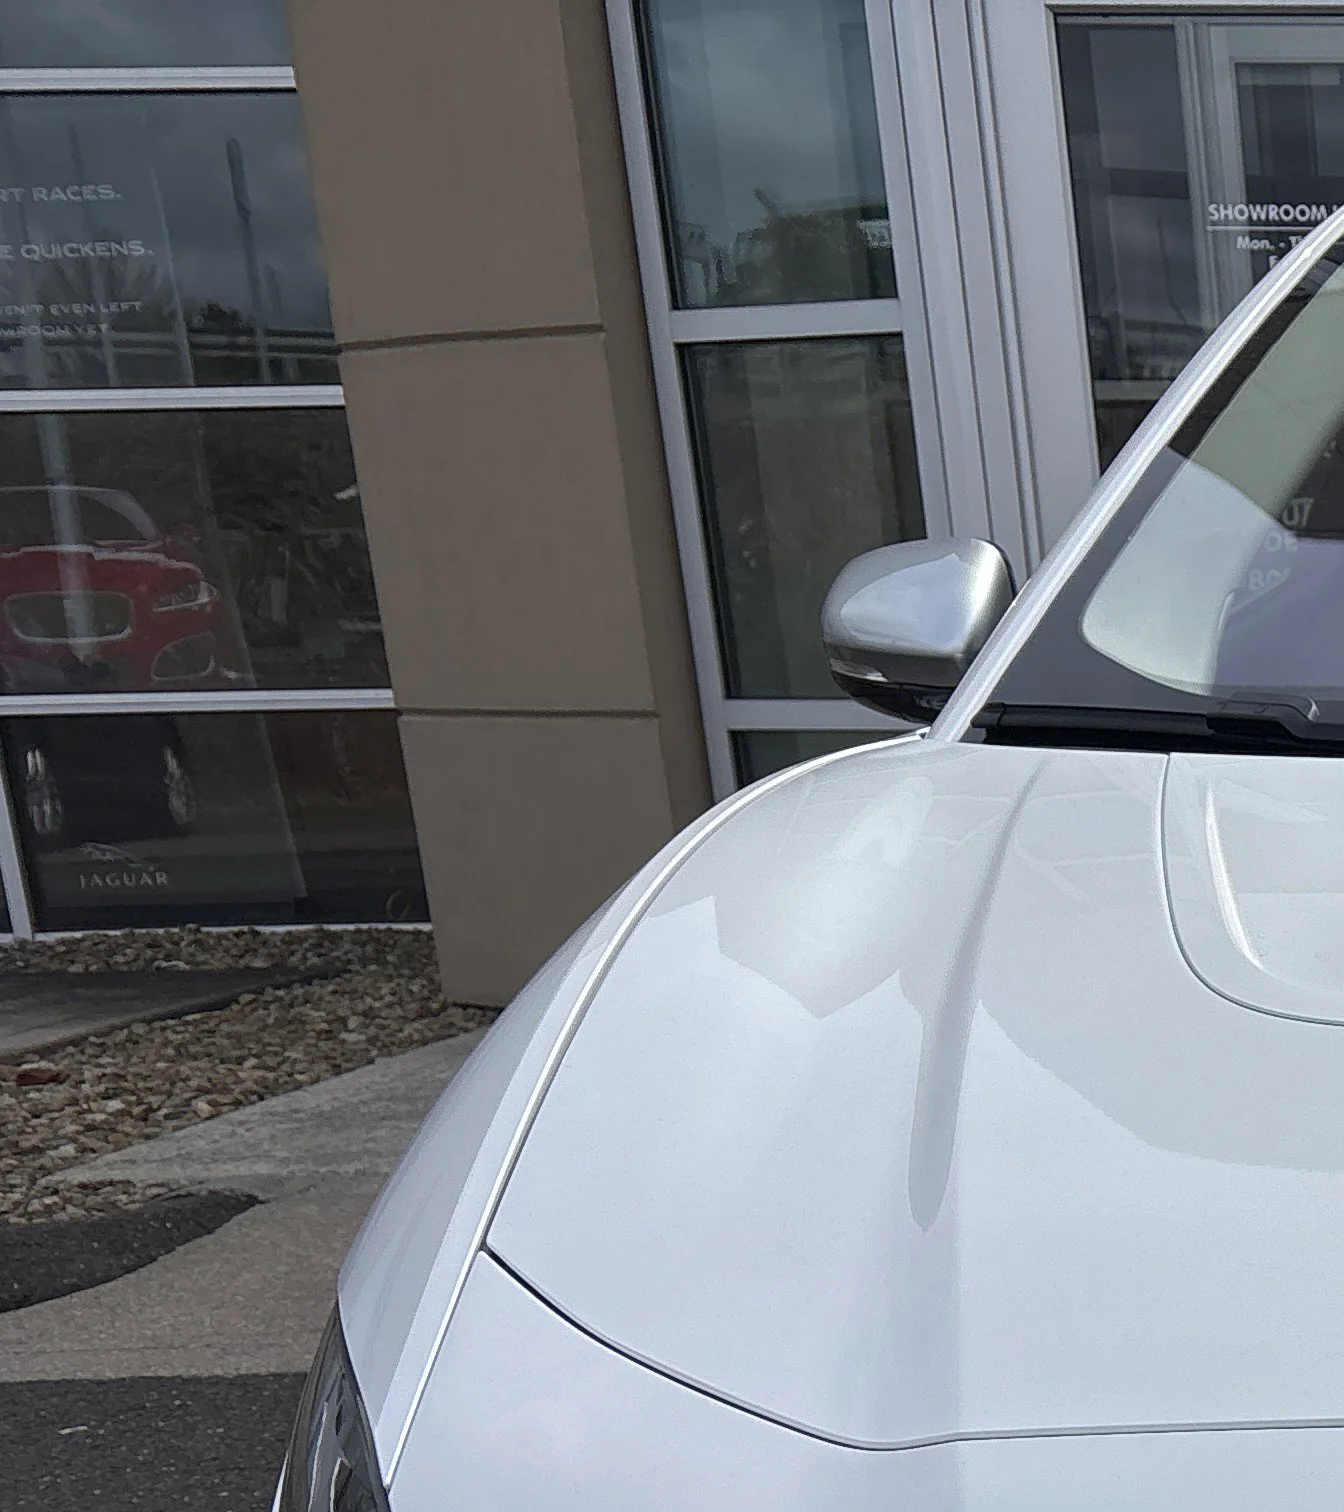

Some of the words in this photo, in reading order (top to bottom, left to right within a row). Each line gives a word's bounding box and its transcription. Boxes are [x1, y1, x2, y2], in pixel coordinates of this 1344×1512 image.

[31, 184, 122, 202] RACES.
[1207, 203, 1328, 221] SHOWROOM
[20, 240, 155, 262] QUICKENS.
[1236, 235, 1276, 251] Mon.
[50, 303, 95, 316] EVEN
[100, 301, 142, 313] LEFT
[79, 871, 168, 890] JAGUAR
